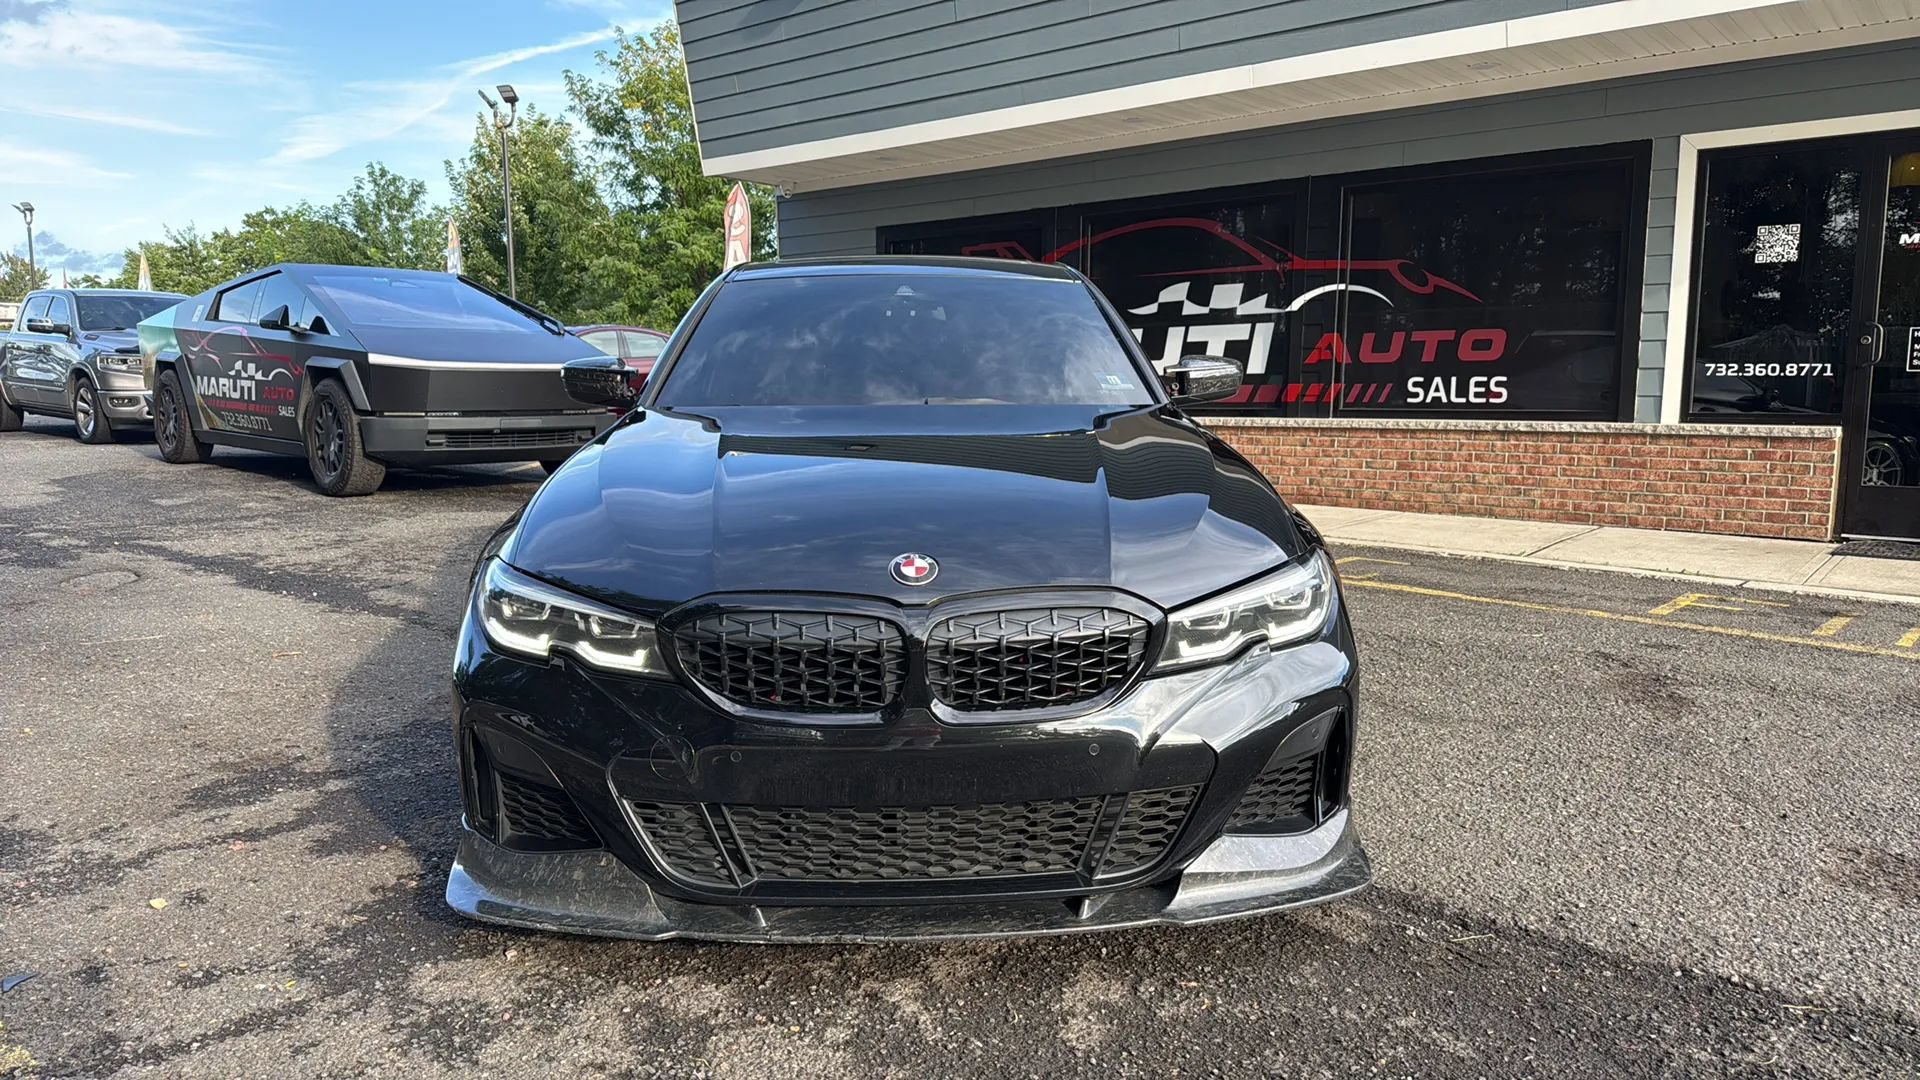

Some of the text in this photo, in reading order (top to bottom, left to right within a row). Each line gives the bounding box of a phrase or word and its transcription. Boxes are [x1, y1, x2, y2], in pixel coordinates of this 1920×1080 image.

[1130, 322, 1508, 376] UTI AUTO
[1704, 363, 1834, 377] 732.360.8771
[196, 375, 295, 401] MARUTI AUTO
[1406, 375, 1508, 403] SALES
[278, 405, 295, 417] SALES
